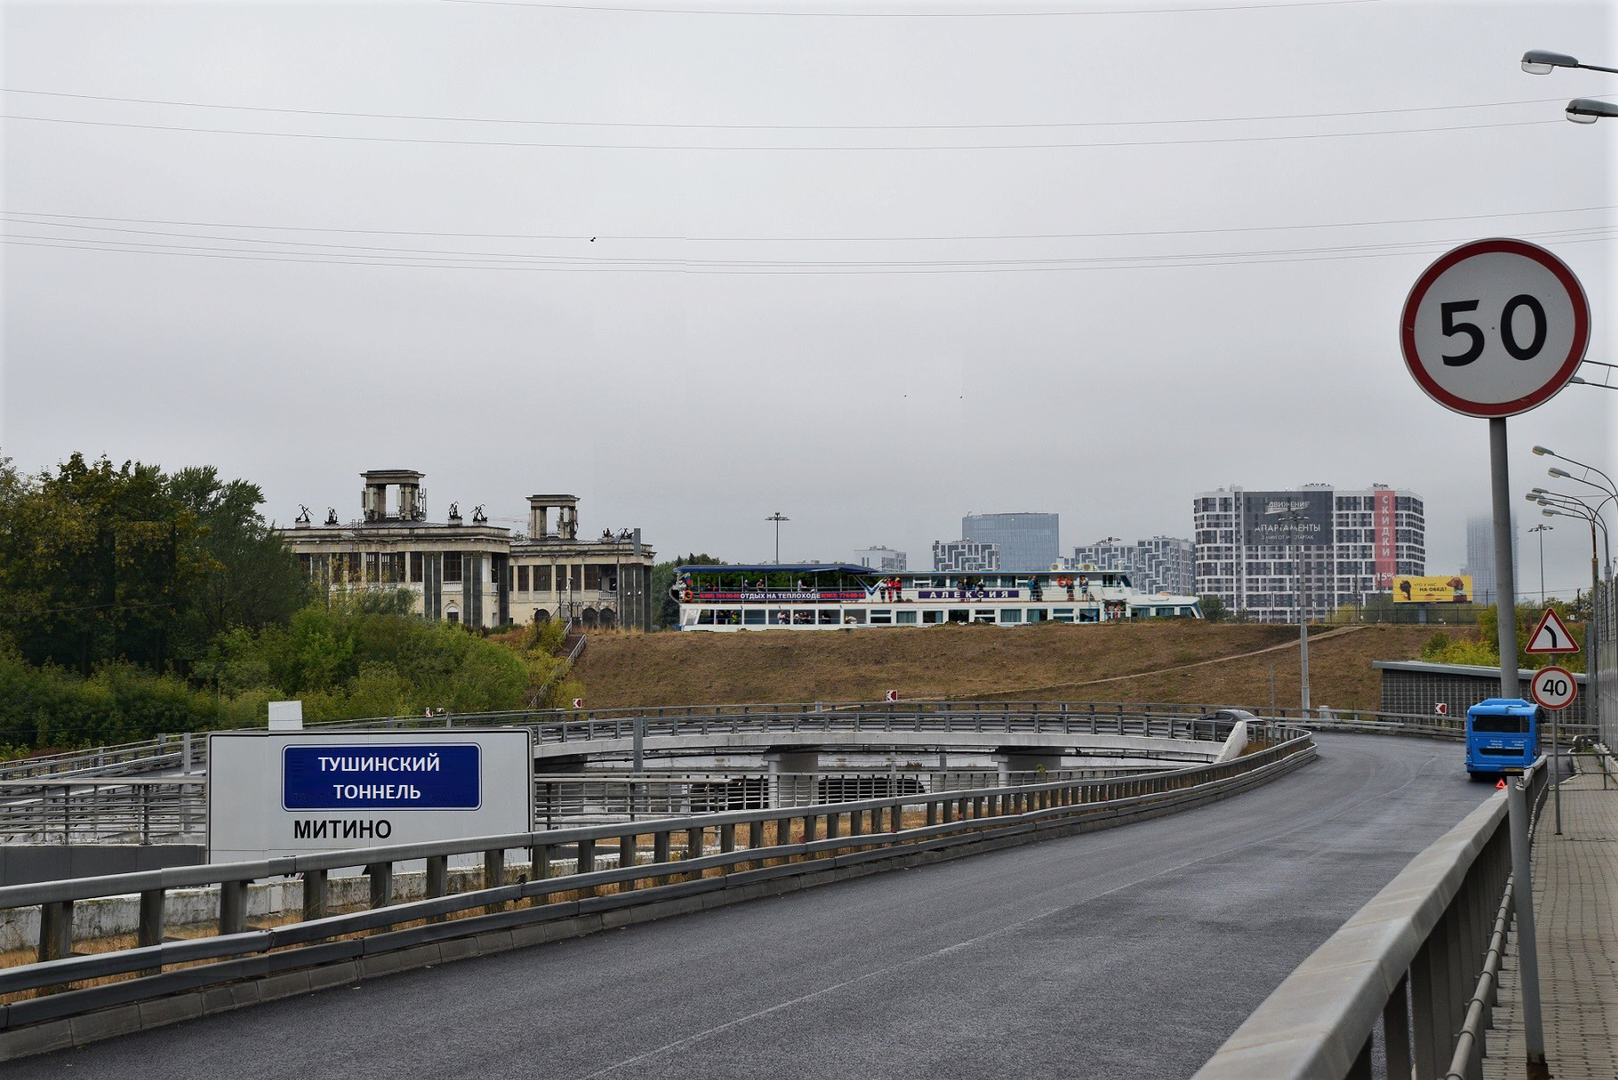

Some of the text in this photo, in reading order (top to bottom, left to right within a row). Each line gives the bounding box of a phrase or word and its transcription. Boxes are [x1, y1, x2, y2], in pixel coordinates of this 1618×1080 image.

[1441, 294, 1547, 367] 50
[1381, 495, 1390, 557] СКИДКИ
[1542, 679, 1567, 696] 40
[318, 753, 440, 772] ТУШИНСКИЙ
[333, 784, 422, 799] ТОННЕЛЬ
[294, 820, 392, 839] МИТИНО
